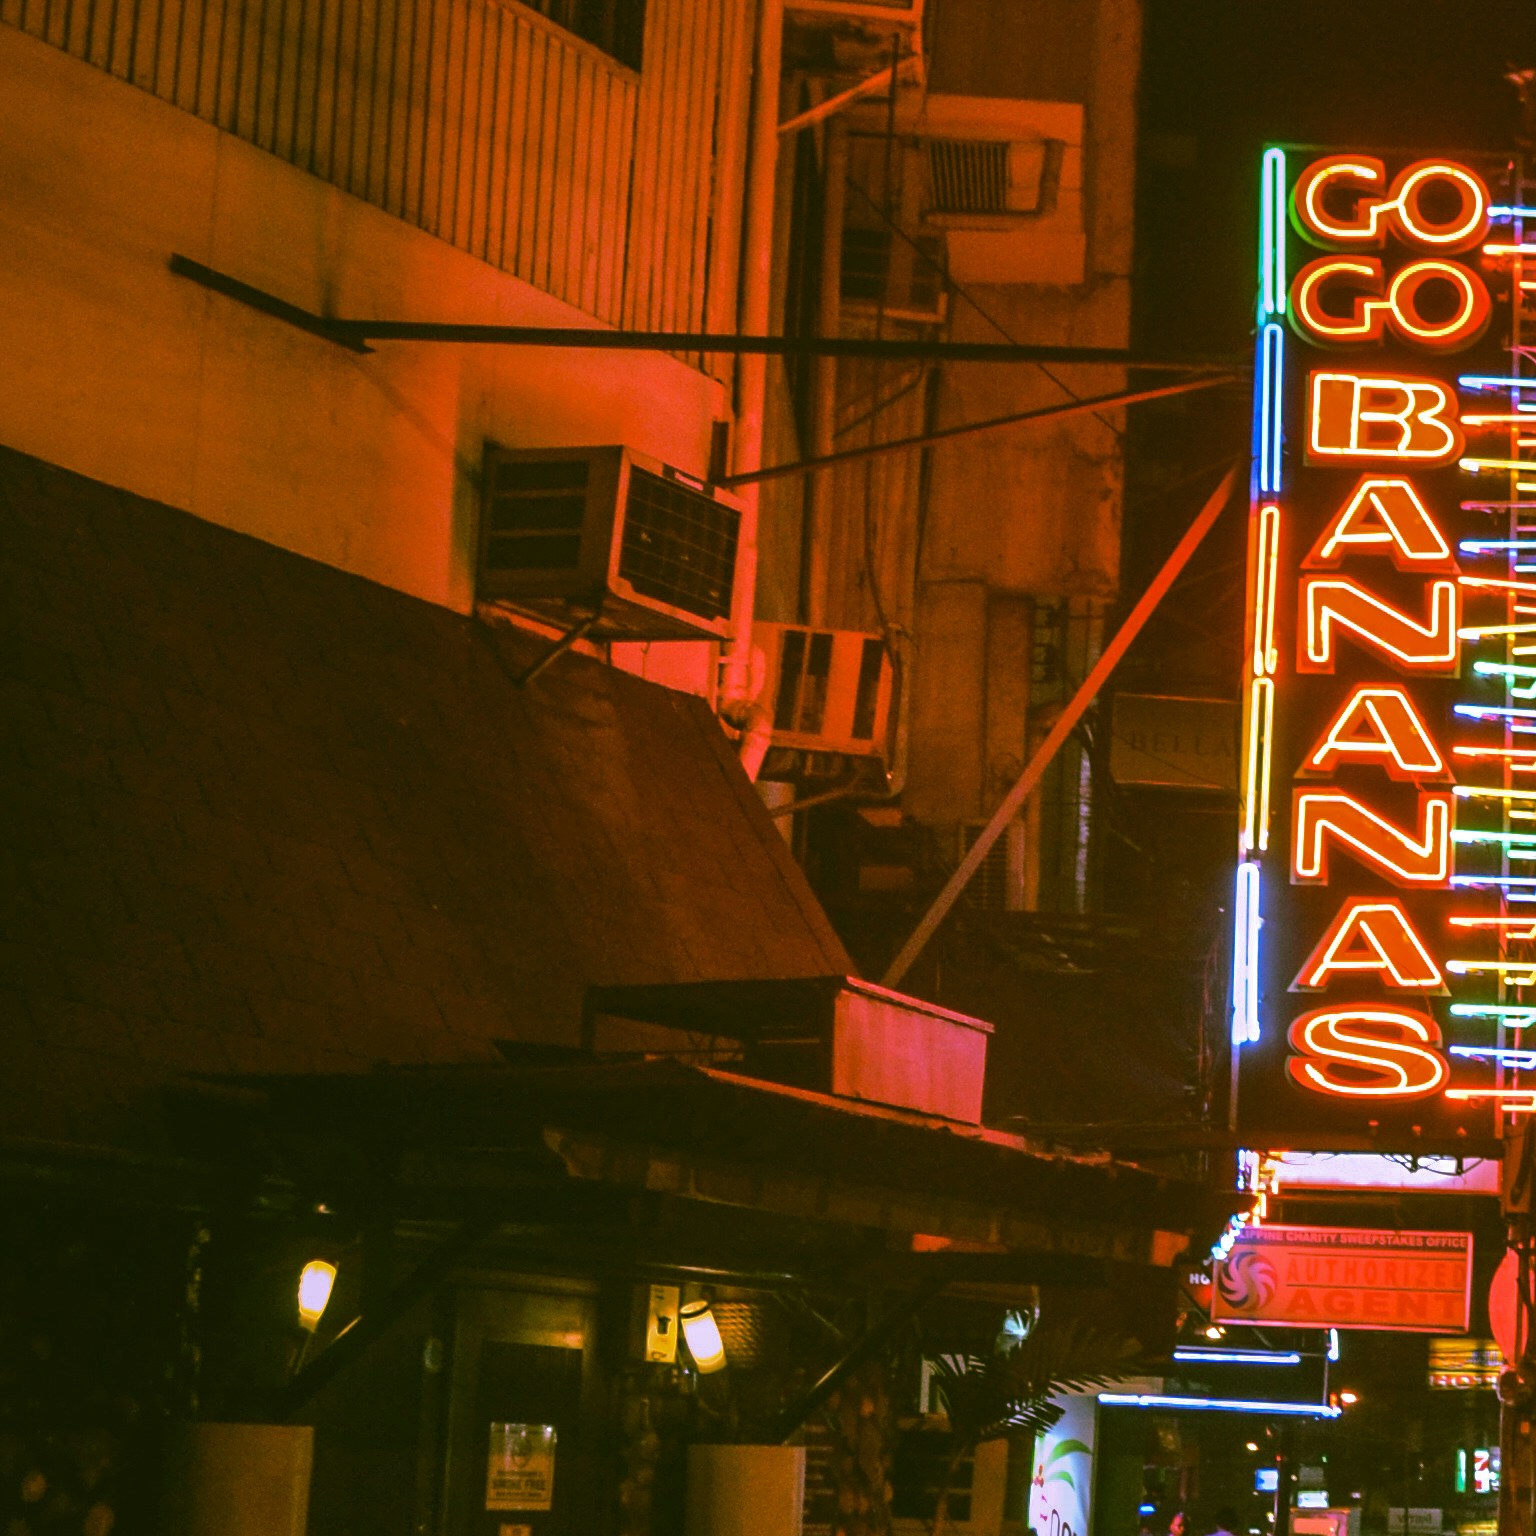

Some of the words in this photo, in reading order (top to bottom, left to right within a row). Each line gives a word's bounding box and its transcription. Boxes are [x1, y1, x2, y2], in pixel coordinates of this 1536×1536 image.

[1285, 152, 1491, 252] GO
[1285, 254, 1491, 350] GO
[1285, 368, 1465, 1105] BANANAS
[1285, 1230, 1338, 1244] CHARITY
[1339, 1232, 1424, 1247] SWEEPSTAKES
[1425, 1235, 1467, 1248] OFFICE
[1286, 1257, 1466, 1288] AUTHORIZED
[1285, 1289, 1463, 1320] AGENT
